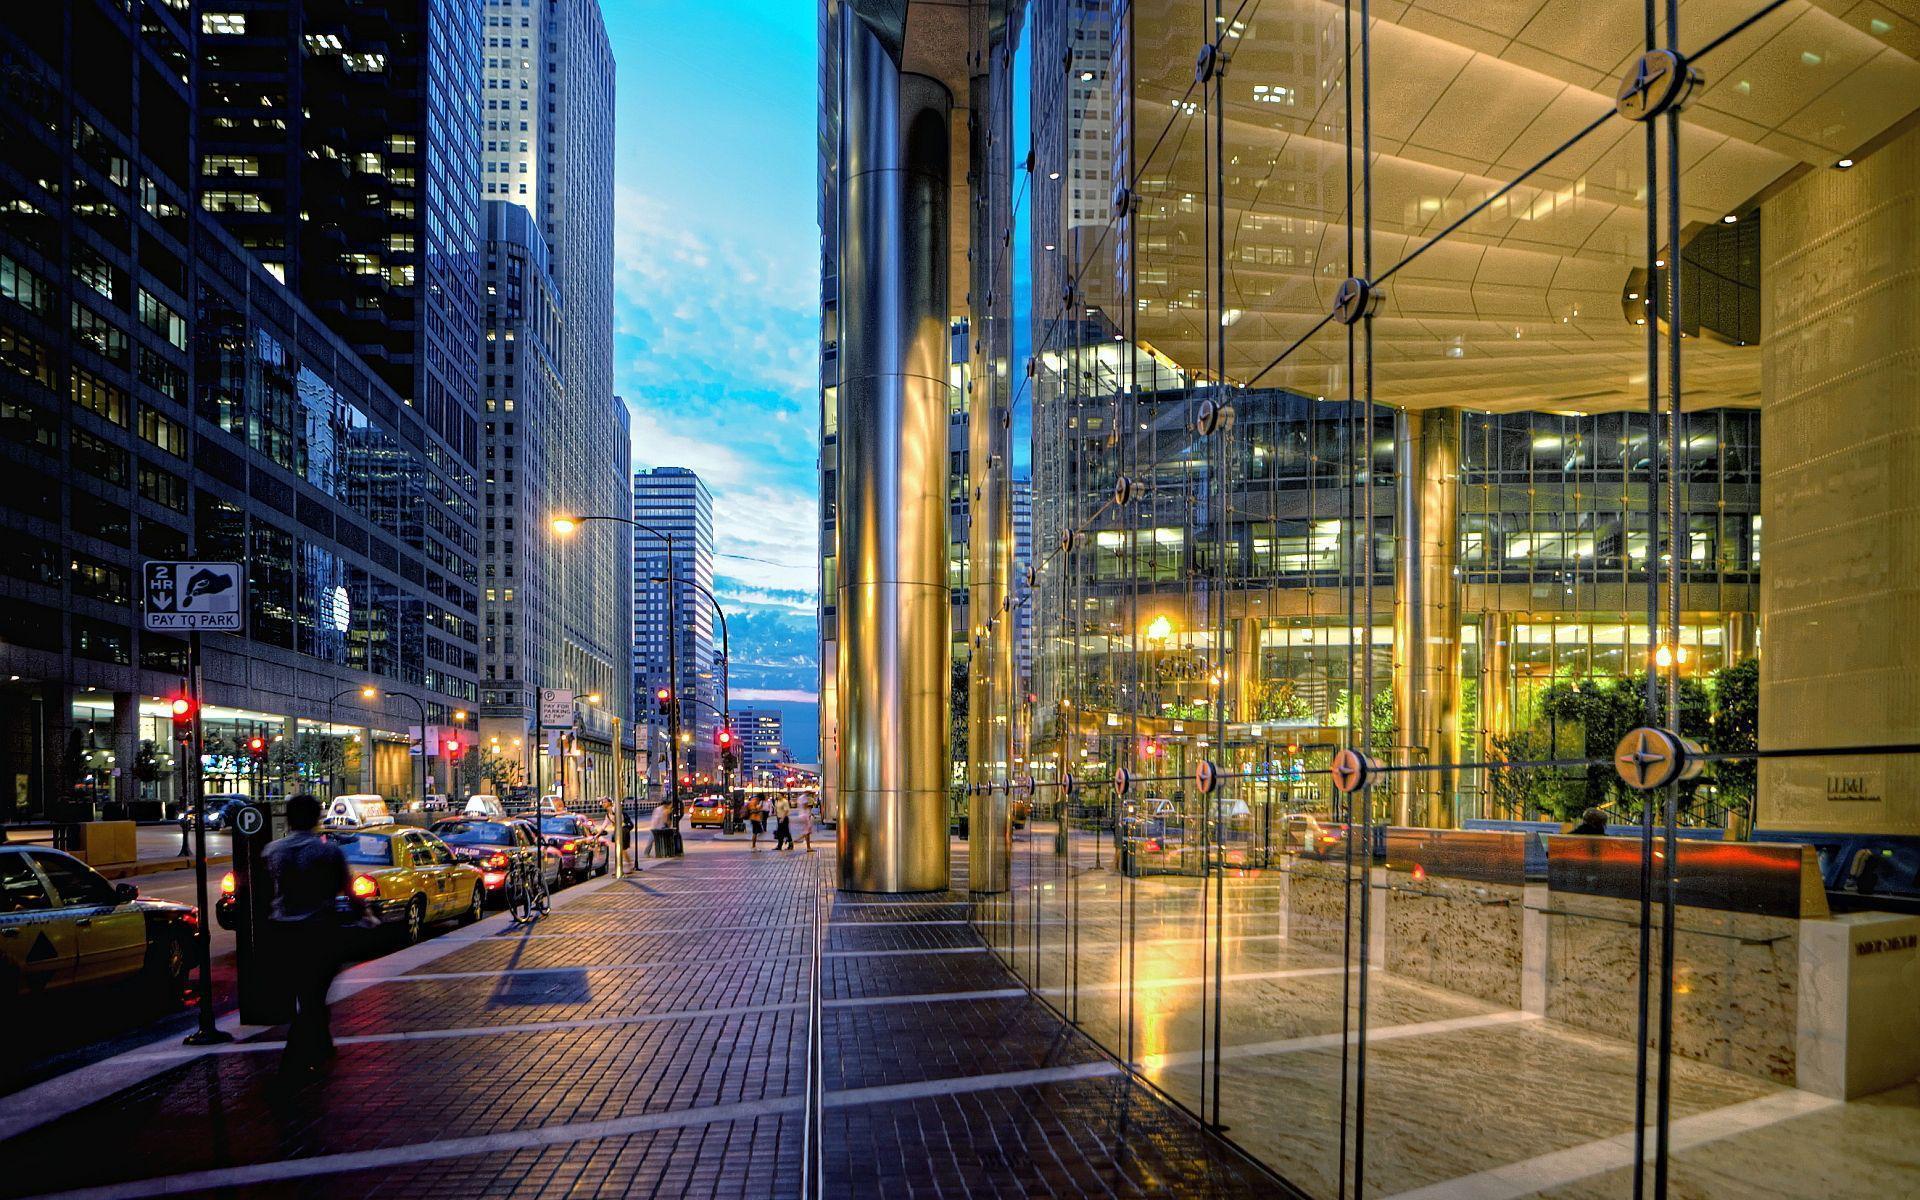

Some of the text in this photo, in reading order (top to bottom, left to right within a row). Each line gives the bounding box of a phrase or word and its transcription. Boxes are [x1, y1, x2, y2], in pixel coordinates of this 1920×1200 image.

[155, 566, 169, 579] 2
[150, 579, 173, 590] HR
[152, 615, 234, 626] PAY TO PARK
